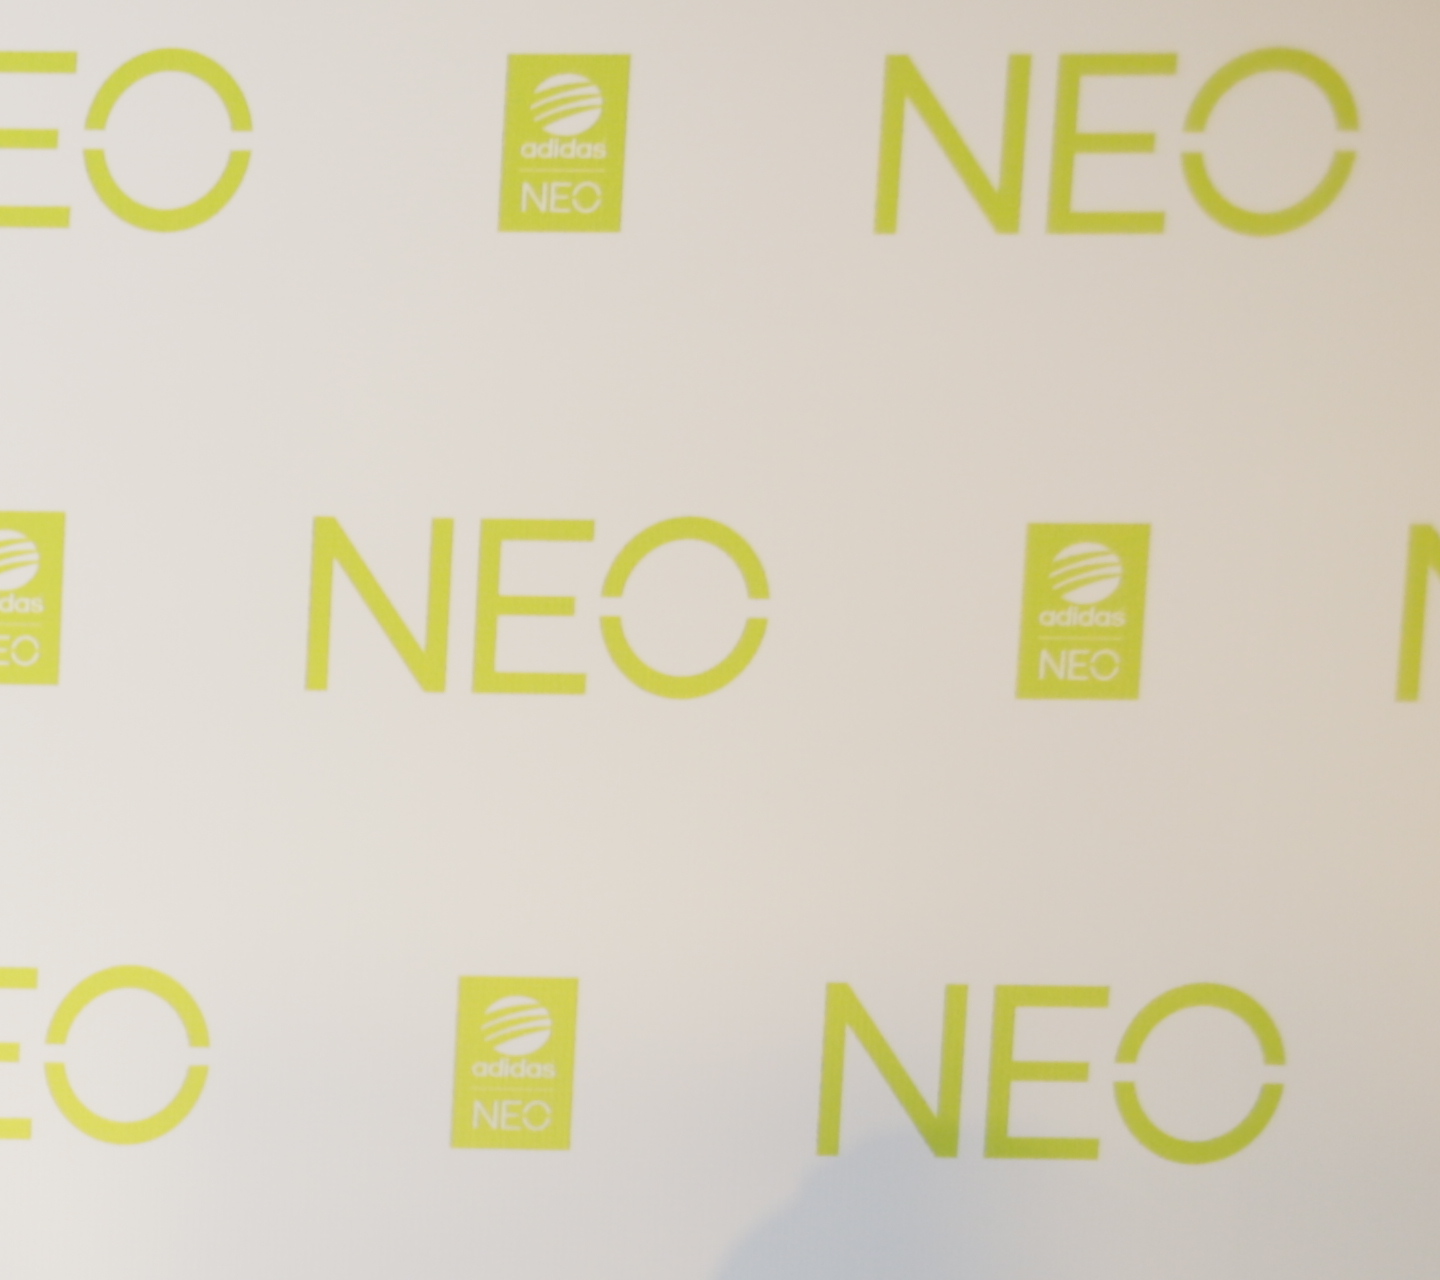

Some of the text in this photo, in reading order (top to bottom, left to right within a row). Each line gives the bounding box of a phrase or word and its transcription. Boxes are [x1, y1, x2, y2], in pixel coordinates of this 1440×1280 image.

[519, 137, 609, 158] adidas
[875, 46, 1360, 237] NEO
[519, 179, 604, 213] NEO
[307, 516, 770, 699] NEO
[1038, 606, 1128, 627] adidas
[1037, 648, 1122, 682] NEO
[471, 1057, 557, 1079] adidas
[818, 982, 1286, 1165] NEO
[472, 1098, 553, 1132] NEO
